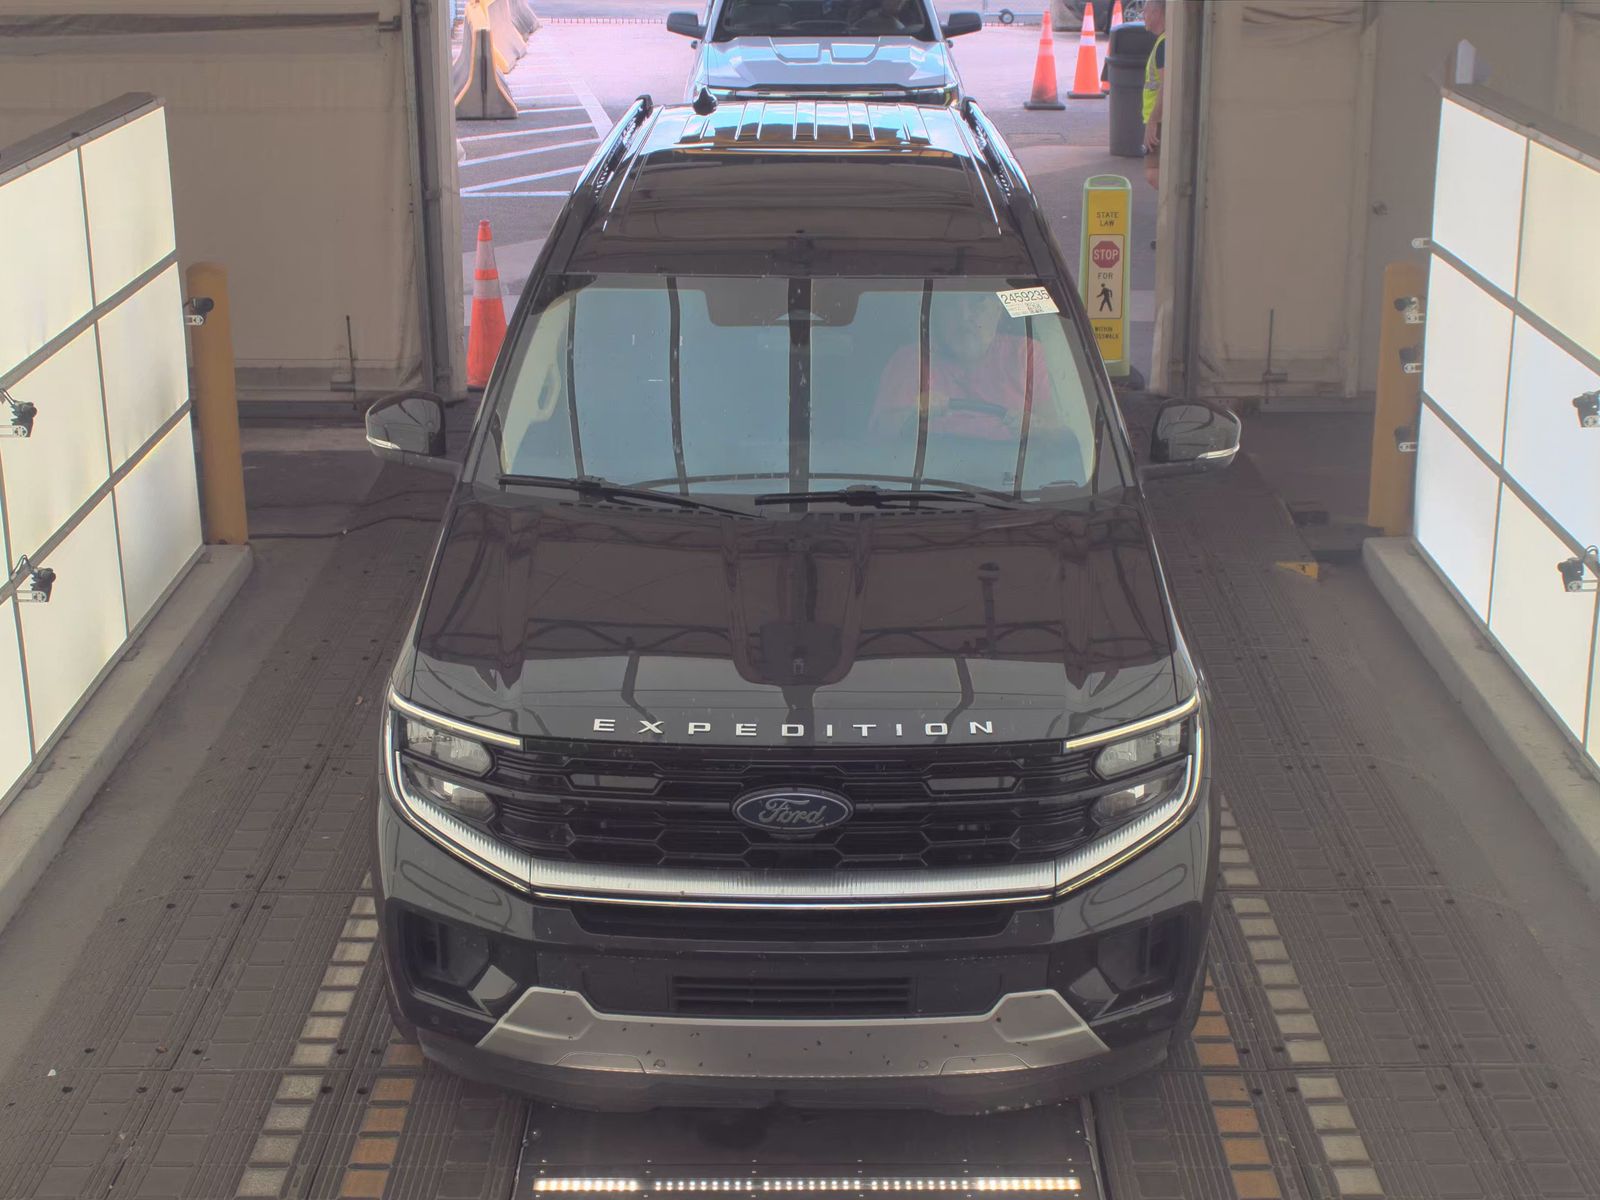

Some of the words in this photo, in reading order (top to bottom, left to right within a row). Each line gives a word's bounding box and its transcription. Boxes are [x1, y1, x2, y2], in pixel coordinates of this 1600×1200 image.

[1096, 211, 1120, 219] STATE
[1099, 219, 1115, 227] LAW
[1093, 248, 1119, 260] STOP
[1098, 272, 1113, 280] FOR
[1001, 289, 1050, 304] 2459235
[593, 718, 993, 737] EXPEDITION
[758, 798, 827, 824] Ford
